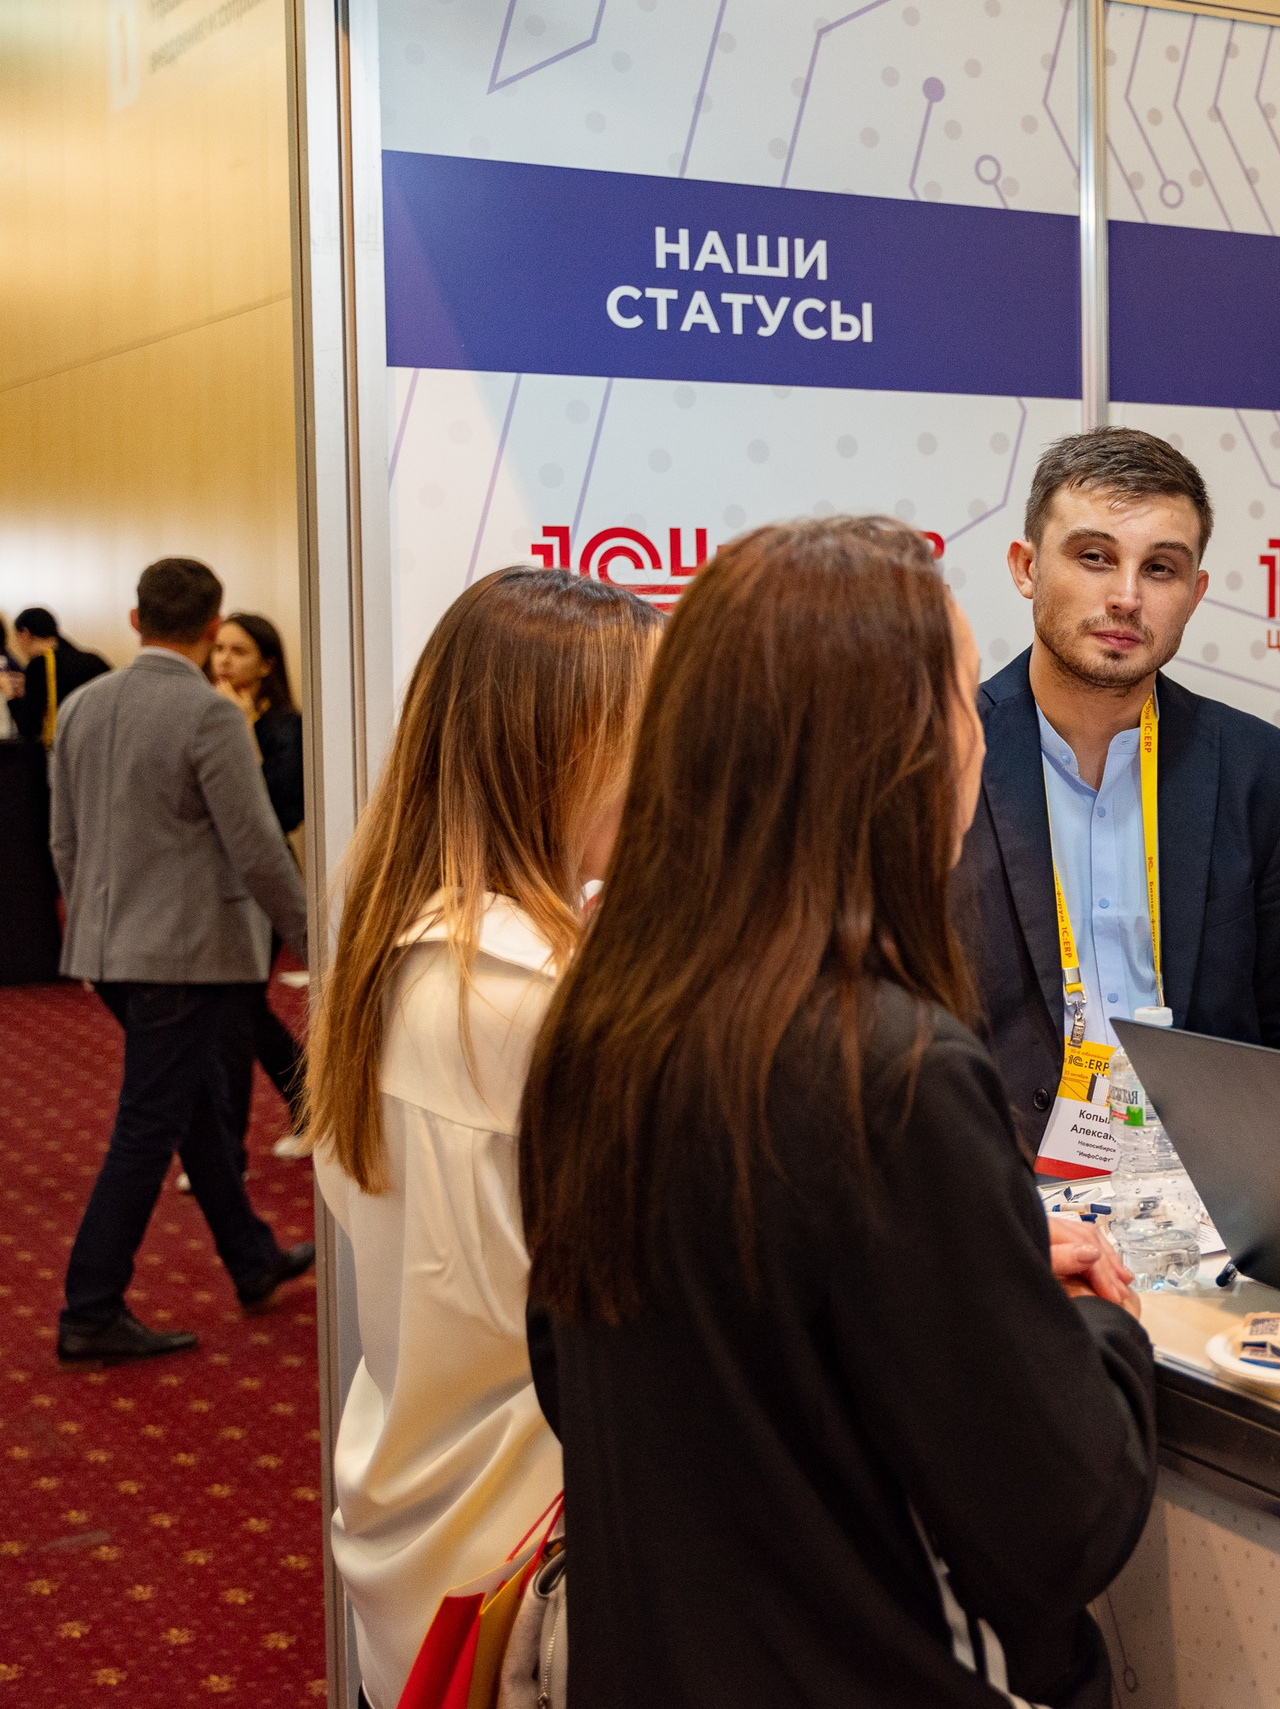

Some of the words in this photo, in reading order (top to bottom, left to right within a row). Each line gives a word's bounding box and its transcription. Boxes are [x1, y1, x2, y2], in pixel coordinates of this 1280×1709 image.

[655, 226, 828, 281] НАШИ
[606, 285, 874, 343] СТАТУСЫ
[1078, 1109, 1110, 1125] Копы
[1070, 1124, 1117, 1143] Алексан
[1078, 1140, 1116, 1153] Новосибирск
